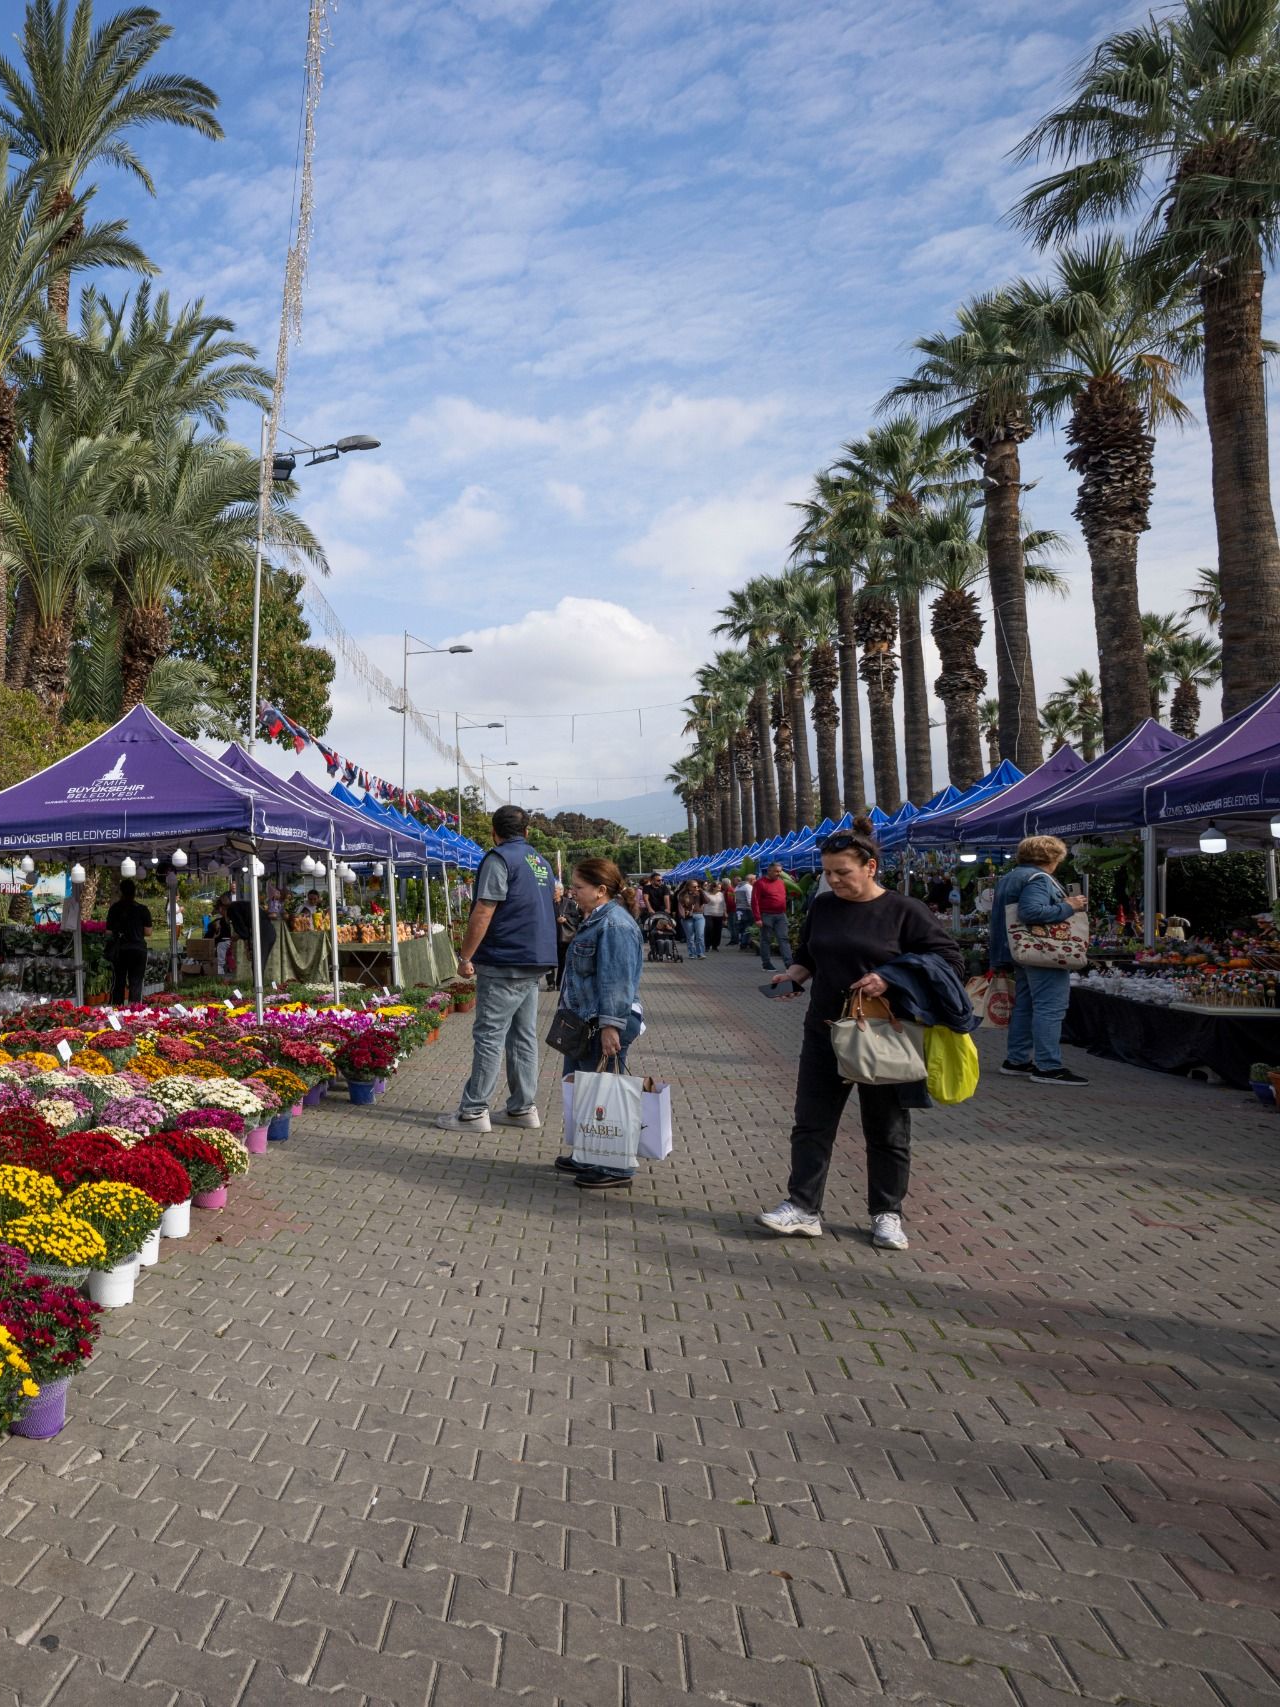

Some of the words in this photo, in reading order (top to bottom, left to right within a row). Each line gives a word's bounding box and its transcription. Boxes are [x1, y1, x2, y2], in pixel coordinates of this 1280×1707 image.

[3, 831, 63, 845] BÜYÜKŞEHİR
[65, 828, 121, 841] BELEDİYESİ
[579, 1123, 624, 1138] MABEL
